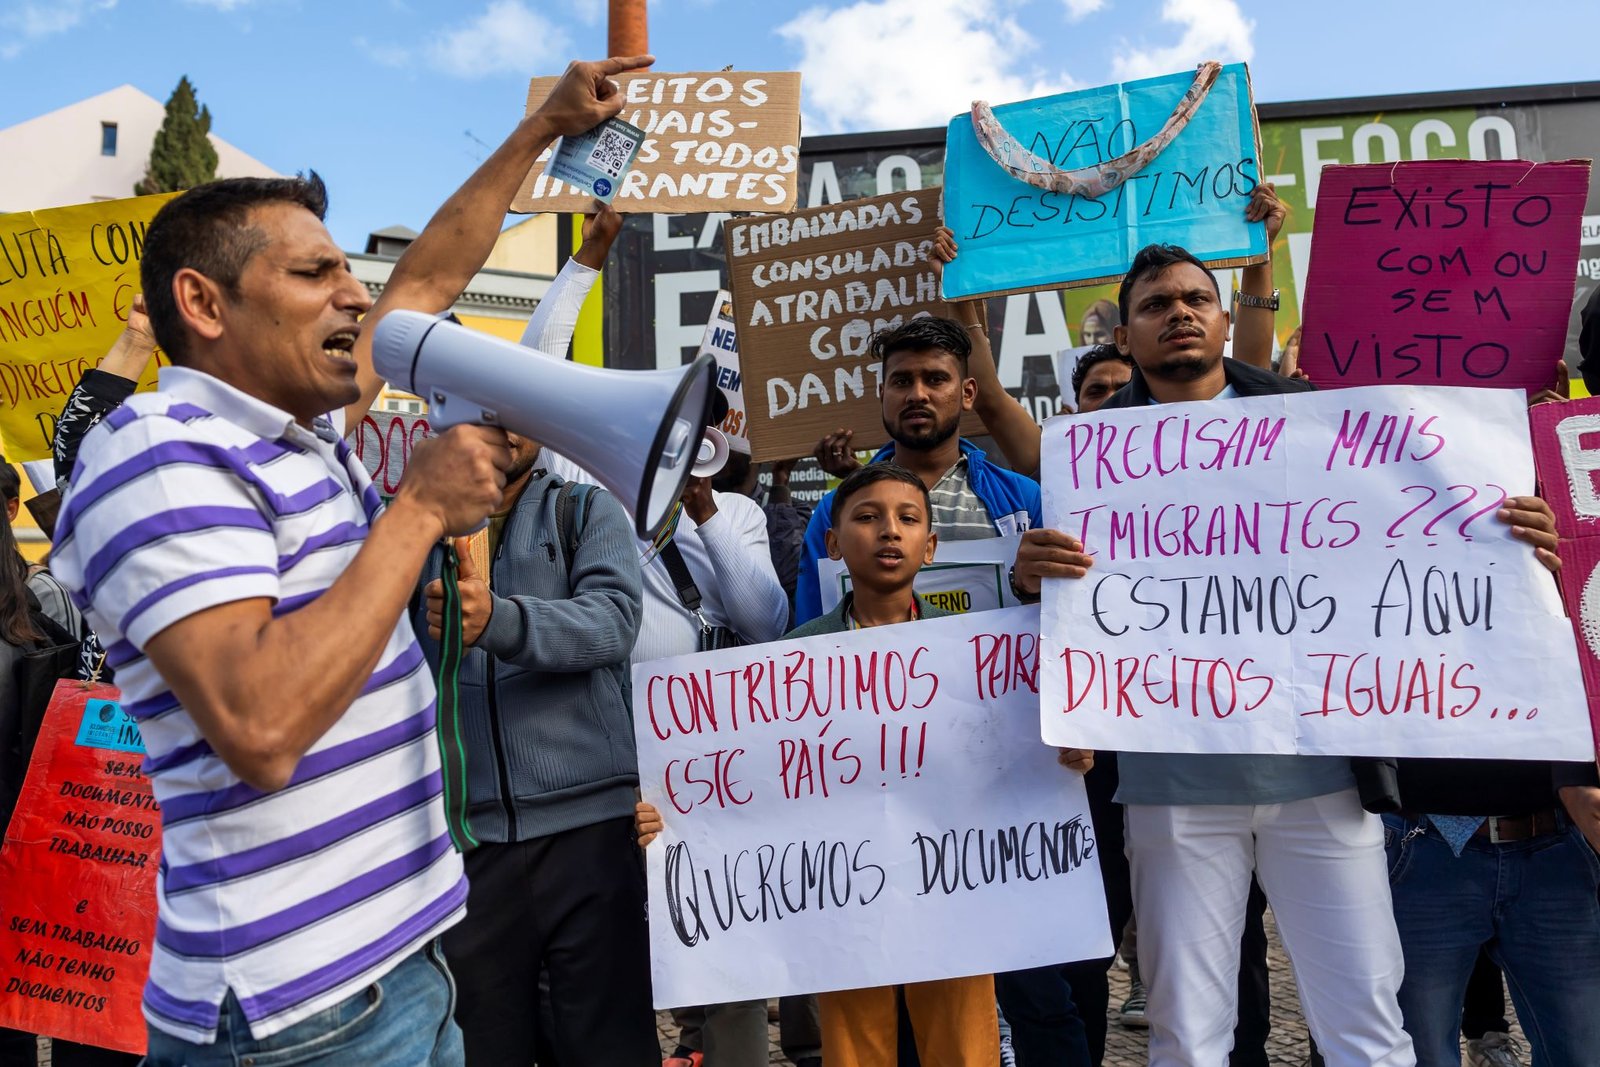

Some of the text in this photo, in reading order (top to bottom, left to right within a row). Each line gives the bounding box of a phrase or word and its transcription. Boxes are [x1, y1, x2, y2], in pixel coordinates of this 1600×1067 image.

[612, 77, 768, 106] EITOS
[670, 140, 799, 173] TODOS
[732, 197, 923, 257] EMBAIXADAS
[0, 220, 153, 286] UTA CON
[752, 240, 935, 287] CONSULADO
[1376, 246, 1547, 277] COM OU
[0, 287, 97, 343] NGUÉM
[766, 362, 883, 419] DANT
[1090, 573, 1338, 638] ESTAMOS
[663, 747, 754, 816] ESTE
[62, 809, 153, 839] NÃO POSSO
[48, 837, 149, 868] TRABALHAR
[664, 839, 886, 948] QUEREMOS
[9, 915, 141, 956] SEM TRABALHO
[15, 946, 116, 982] NÃO TENHO
[5, 976, 108, 1013] DOCUENTOS
